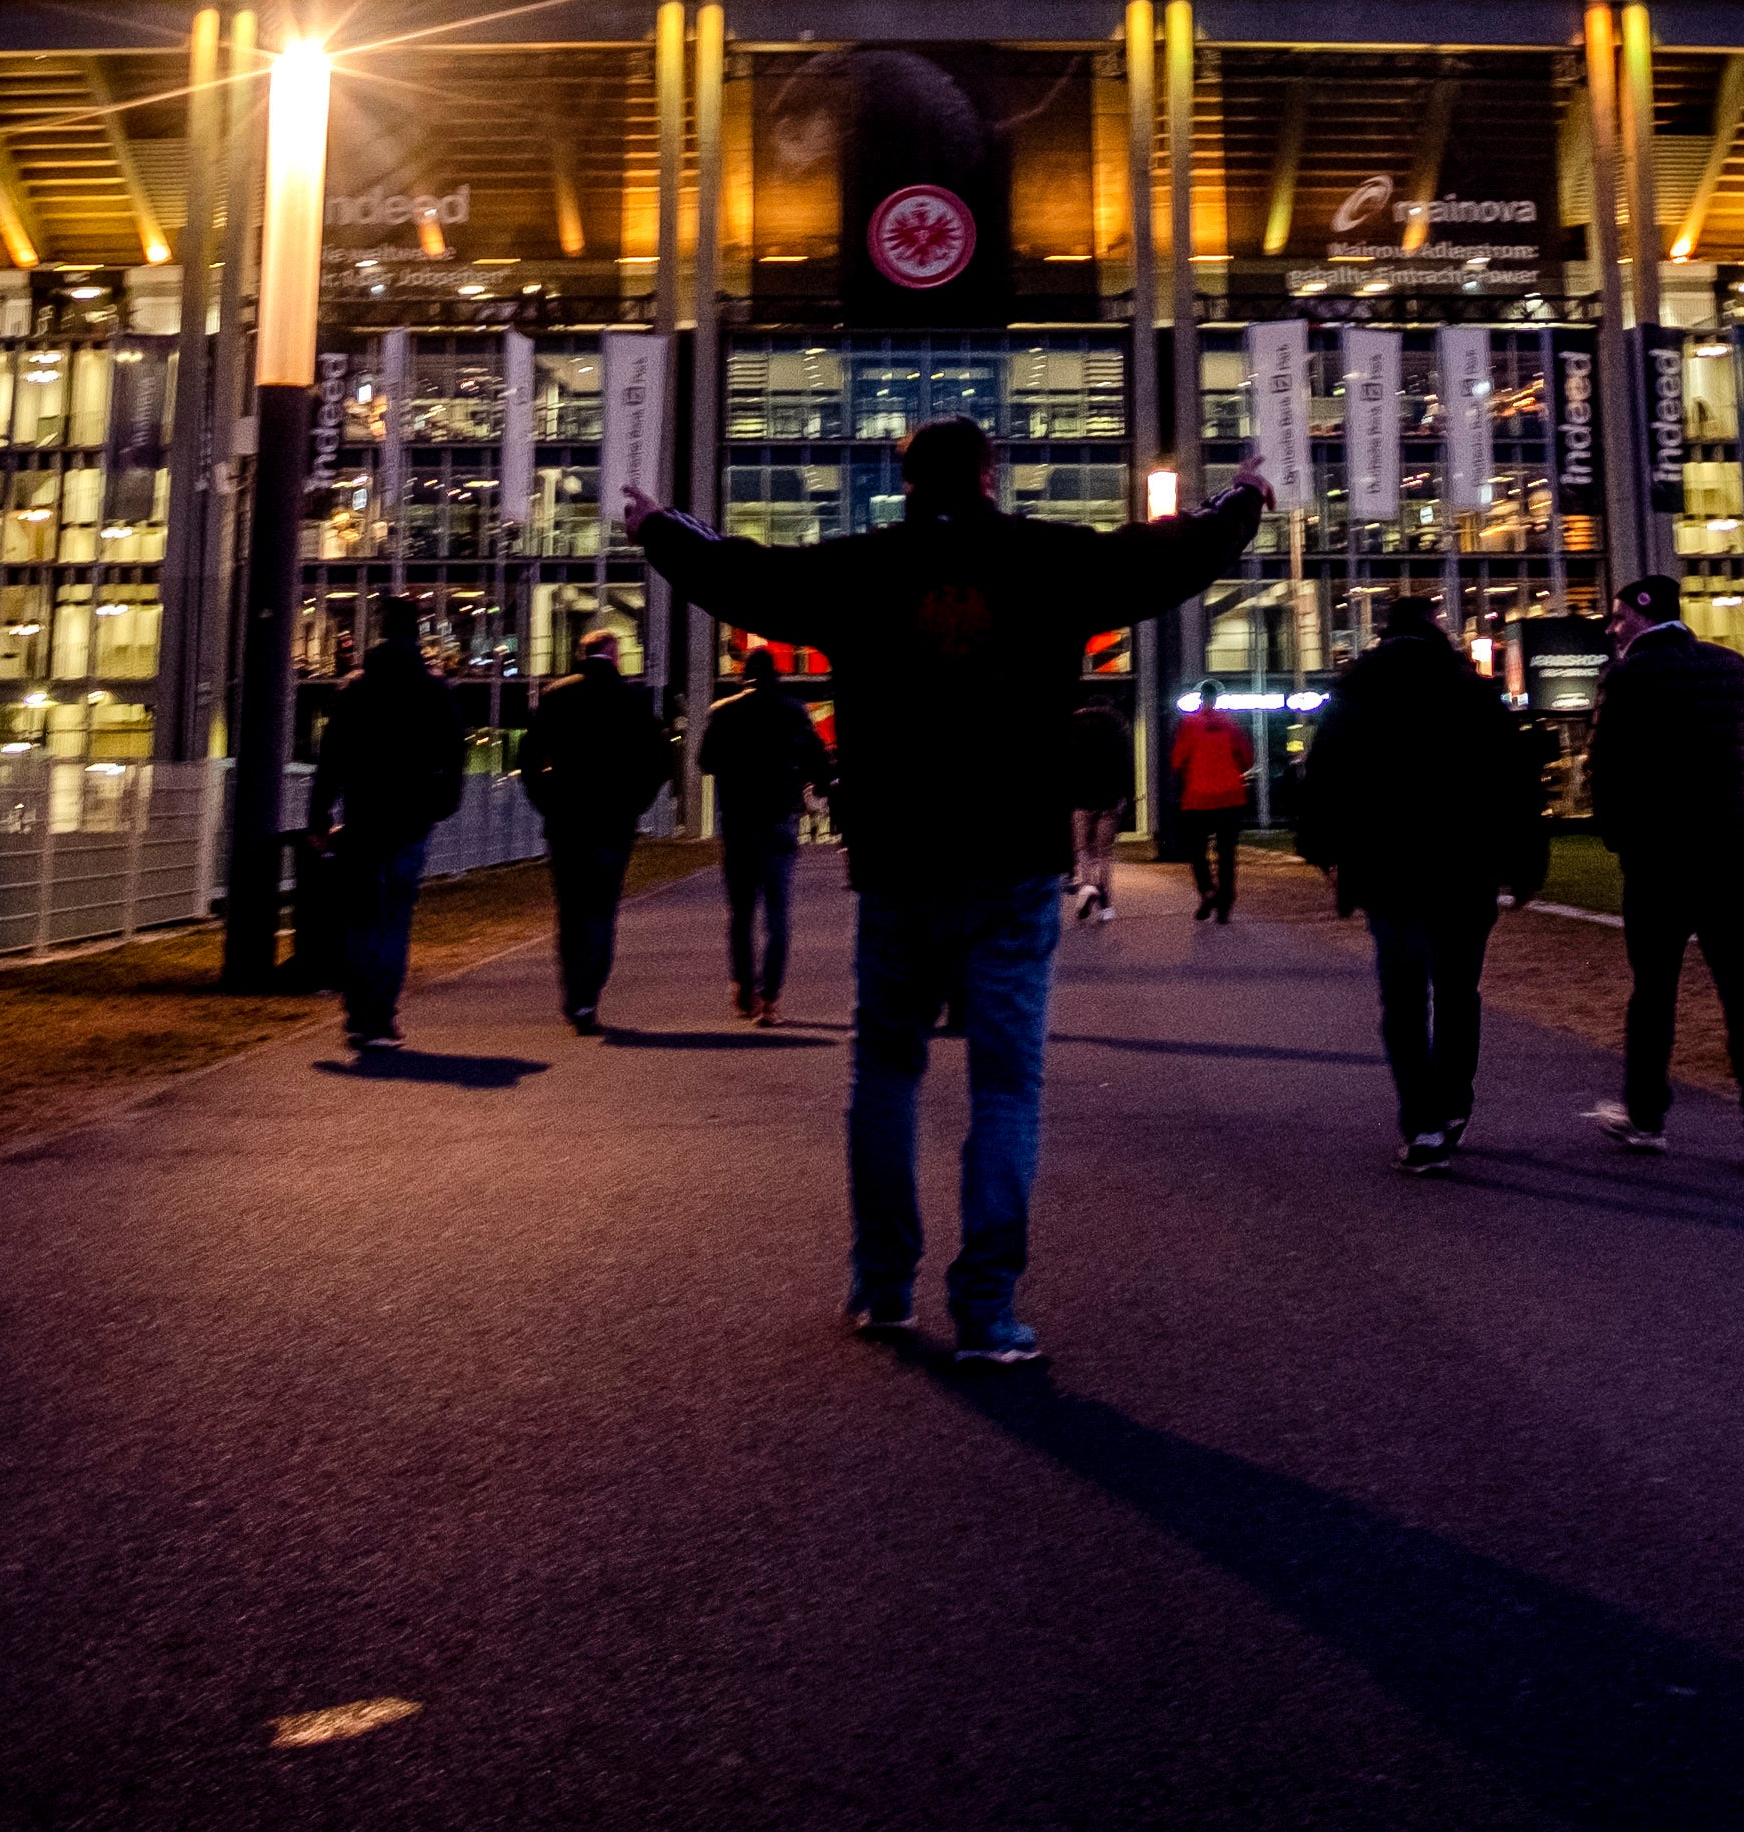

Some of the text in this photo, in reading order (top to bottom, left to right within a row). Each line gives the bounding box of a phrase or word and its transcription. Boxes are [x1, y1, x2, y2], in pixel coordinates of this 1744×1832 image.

[323, 183, 470, 225] ndeed
[1557, 350, 1593, 485] indeed
[1648, 349, 1684, 481] indeed
